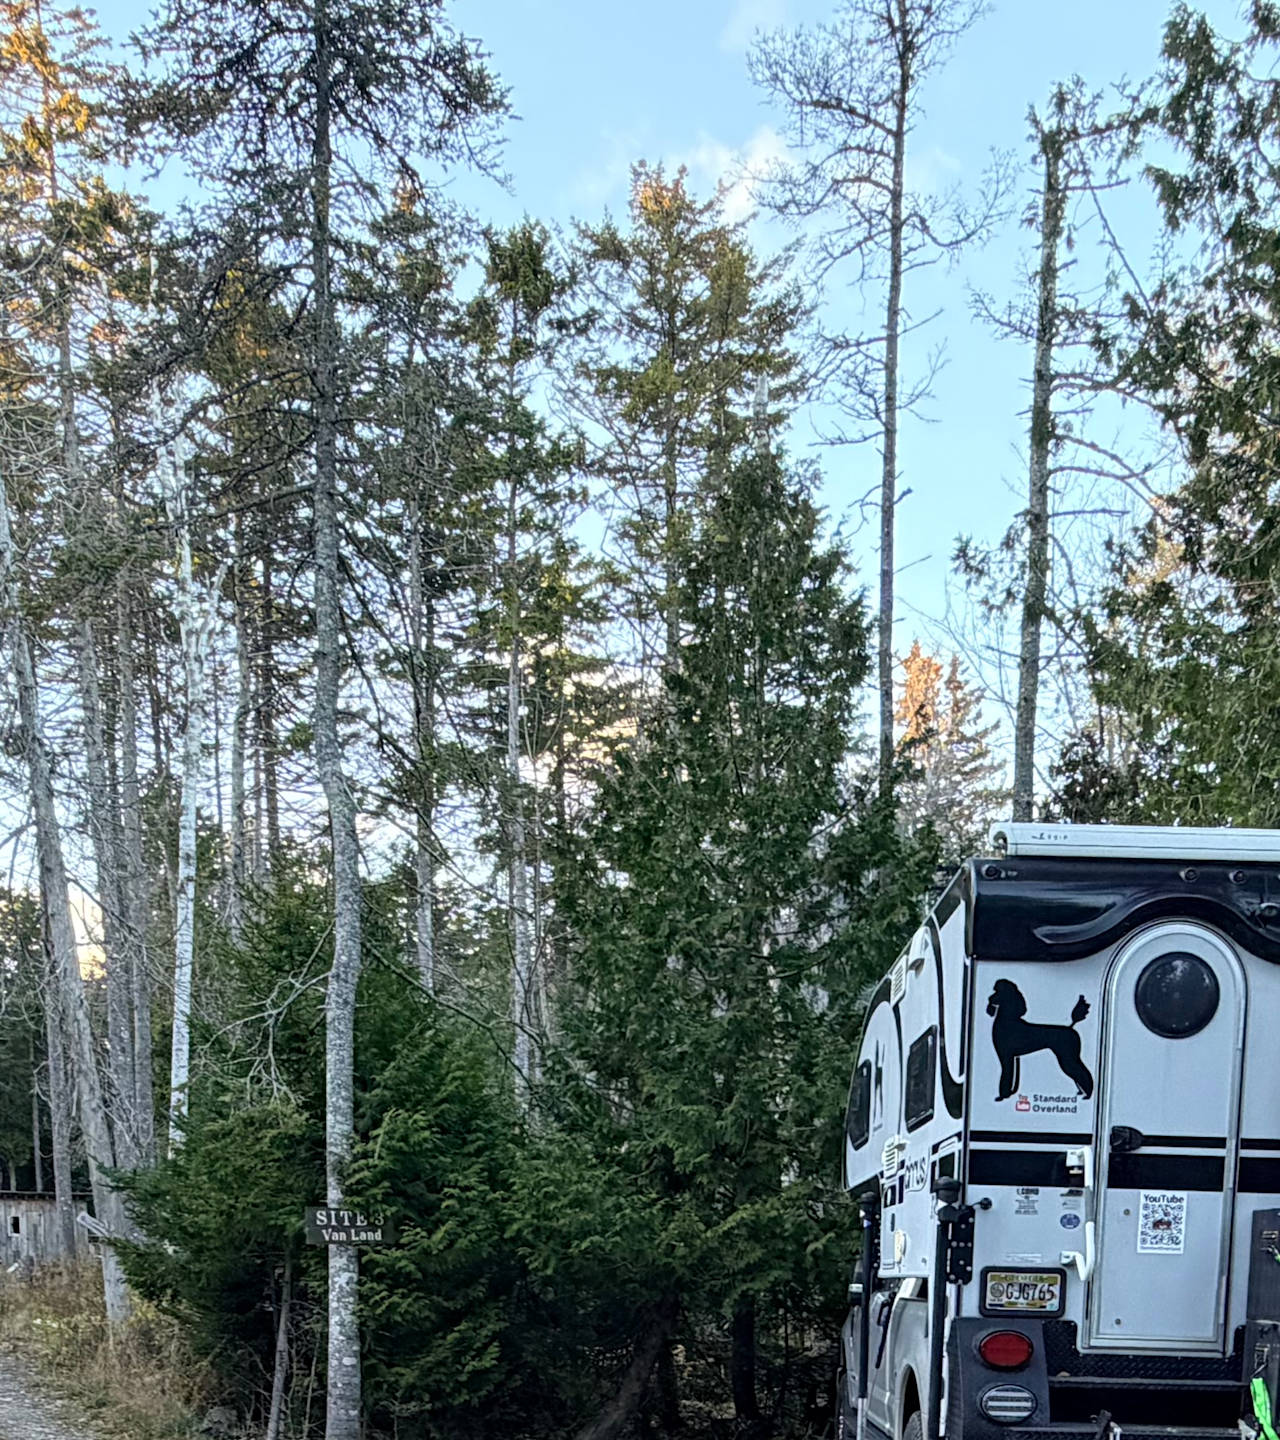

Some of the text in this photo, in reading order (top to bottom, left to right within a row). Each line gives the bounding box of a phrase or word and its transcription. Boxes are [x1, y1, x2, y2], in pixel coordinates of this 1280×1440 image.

[1032, 1094, 1078, 1104] Standard
[1032, 1104, 1078, 1114] Overland
[1143, 1193, 1185, 1204] YouTube
[316, 1210, 385, 1226] SITE 3
[321, 1228, 383, 1241] Van Land
